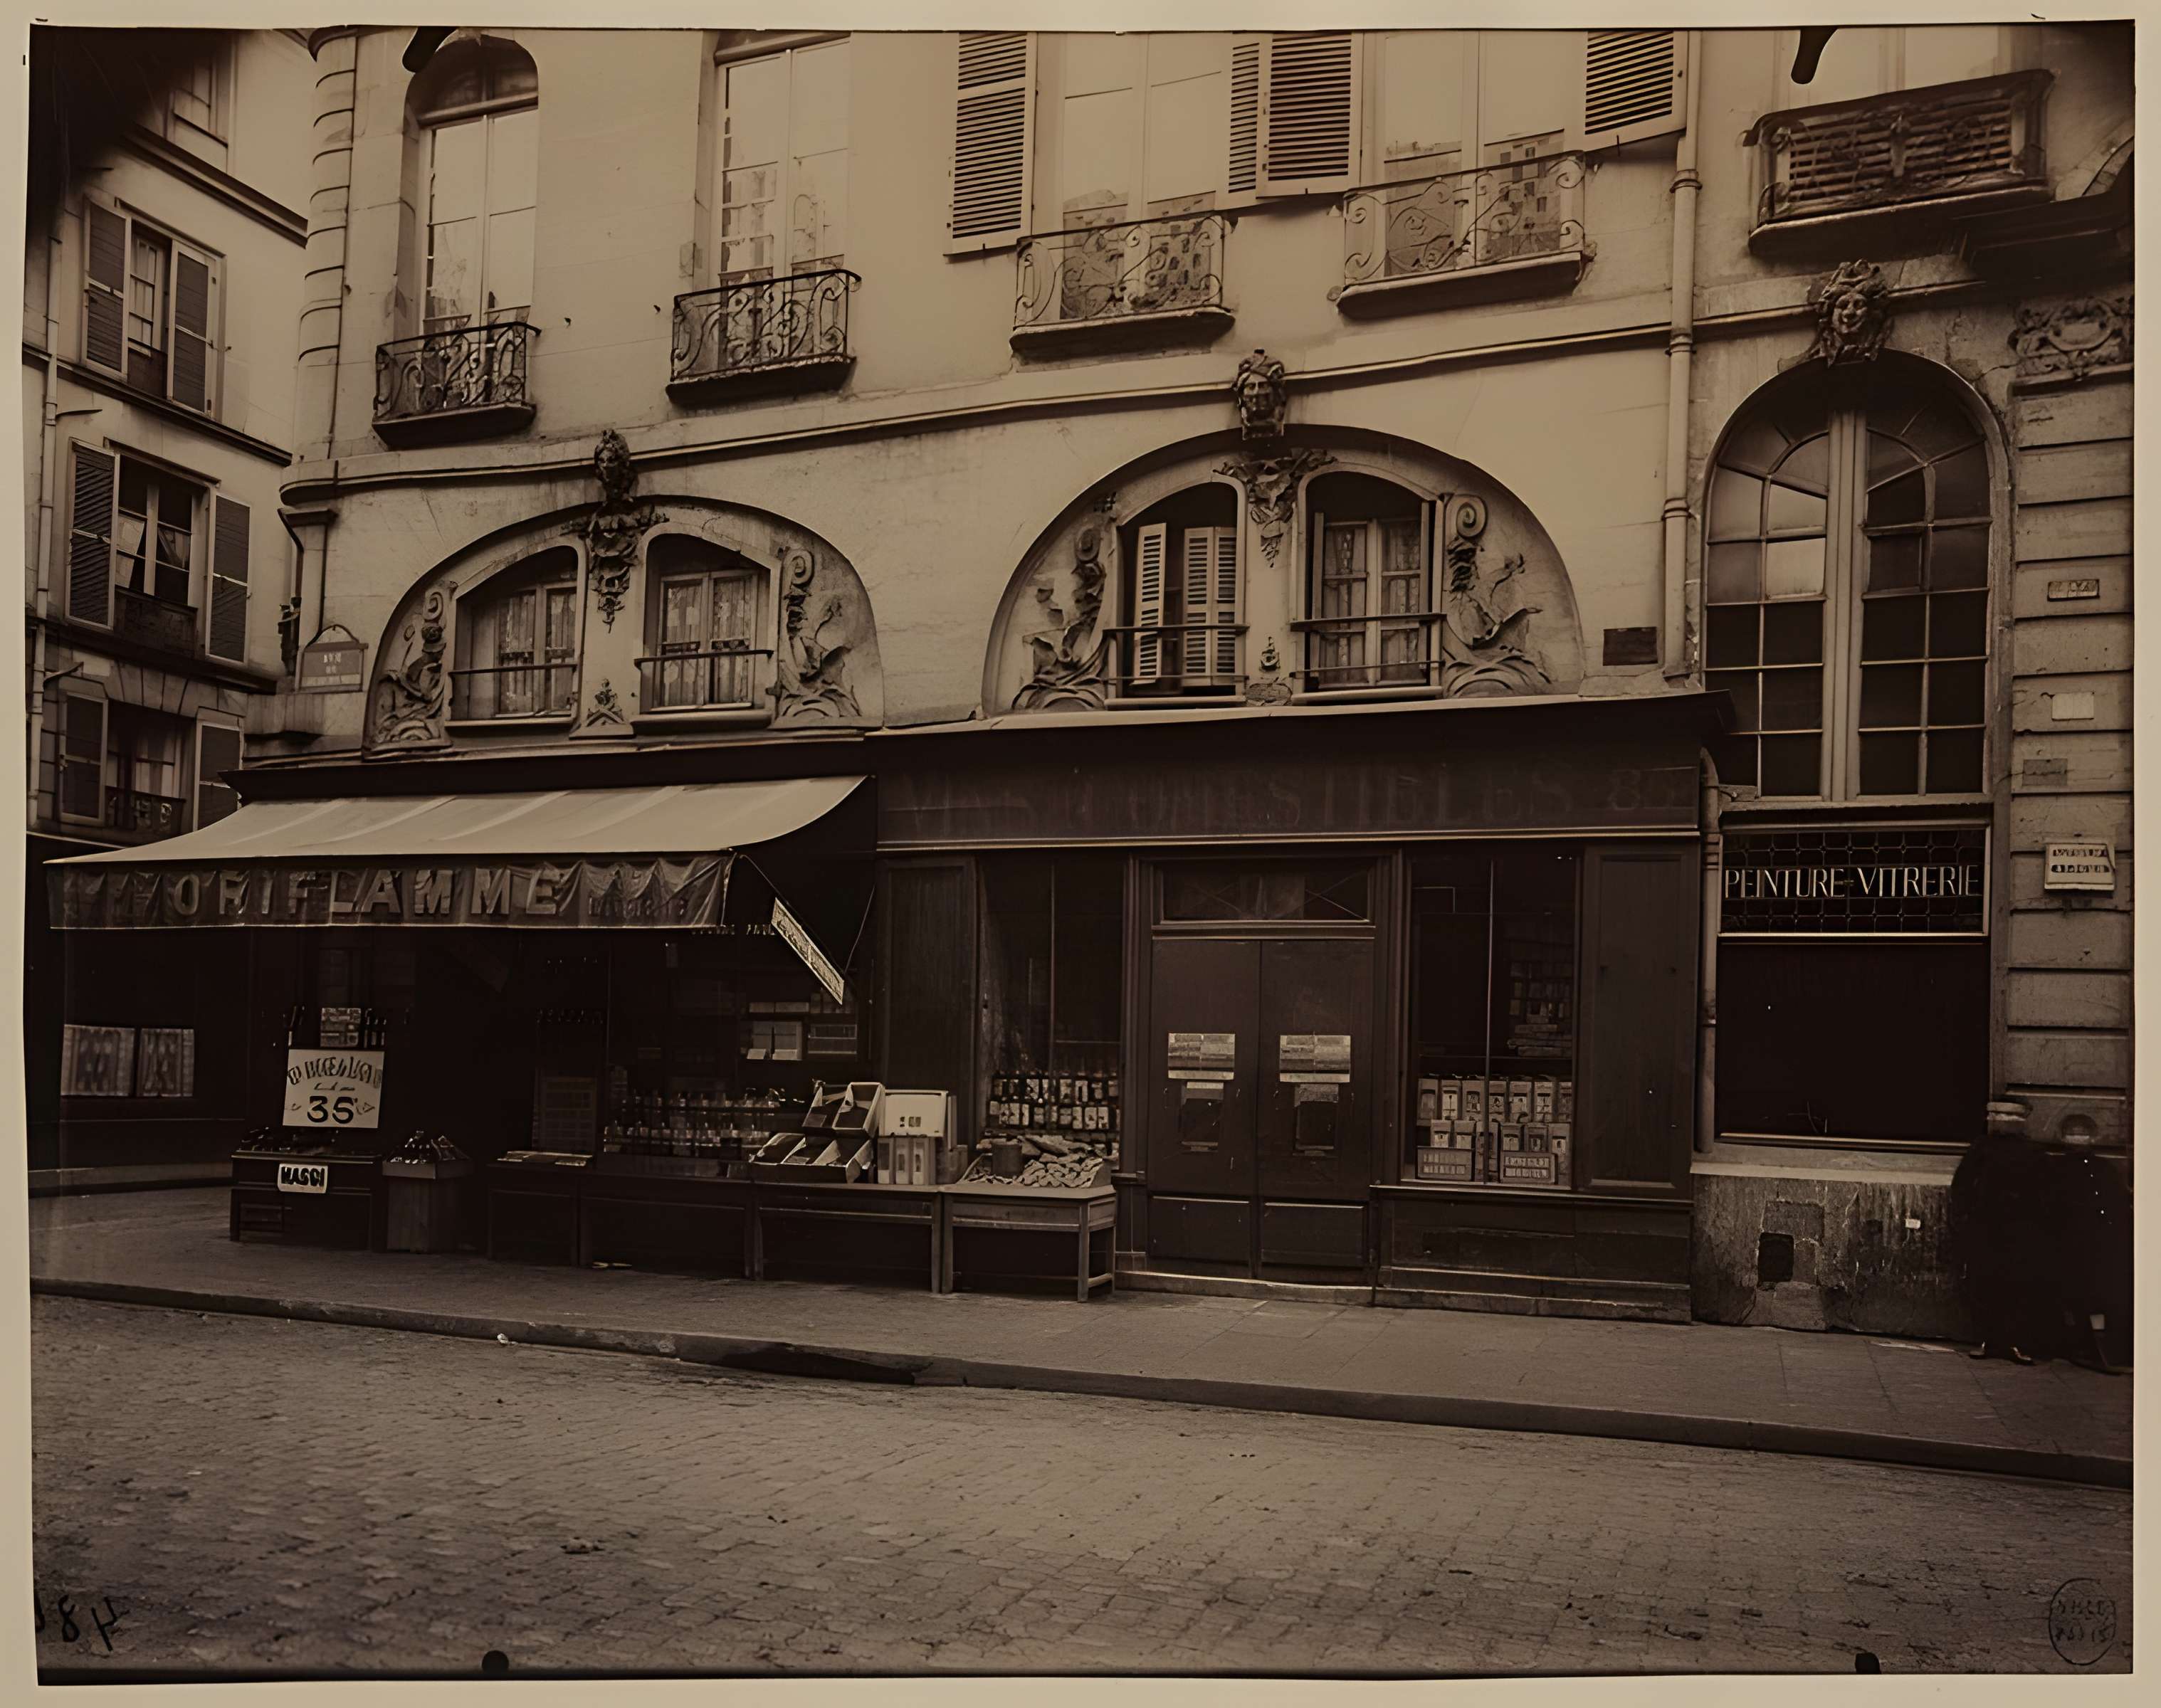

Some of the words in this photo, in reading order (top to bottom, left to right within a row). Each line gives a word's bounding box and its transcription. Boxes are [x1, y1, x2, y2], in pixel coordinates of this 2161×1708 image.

[174, 866, 558, 916] ORIFLAMME
[1725, 868, 1846, 899] PEINTURE
[1856, 865, 1982, 897] VITRERIE
[307, 1095, 354, 1124] 35
